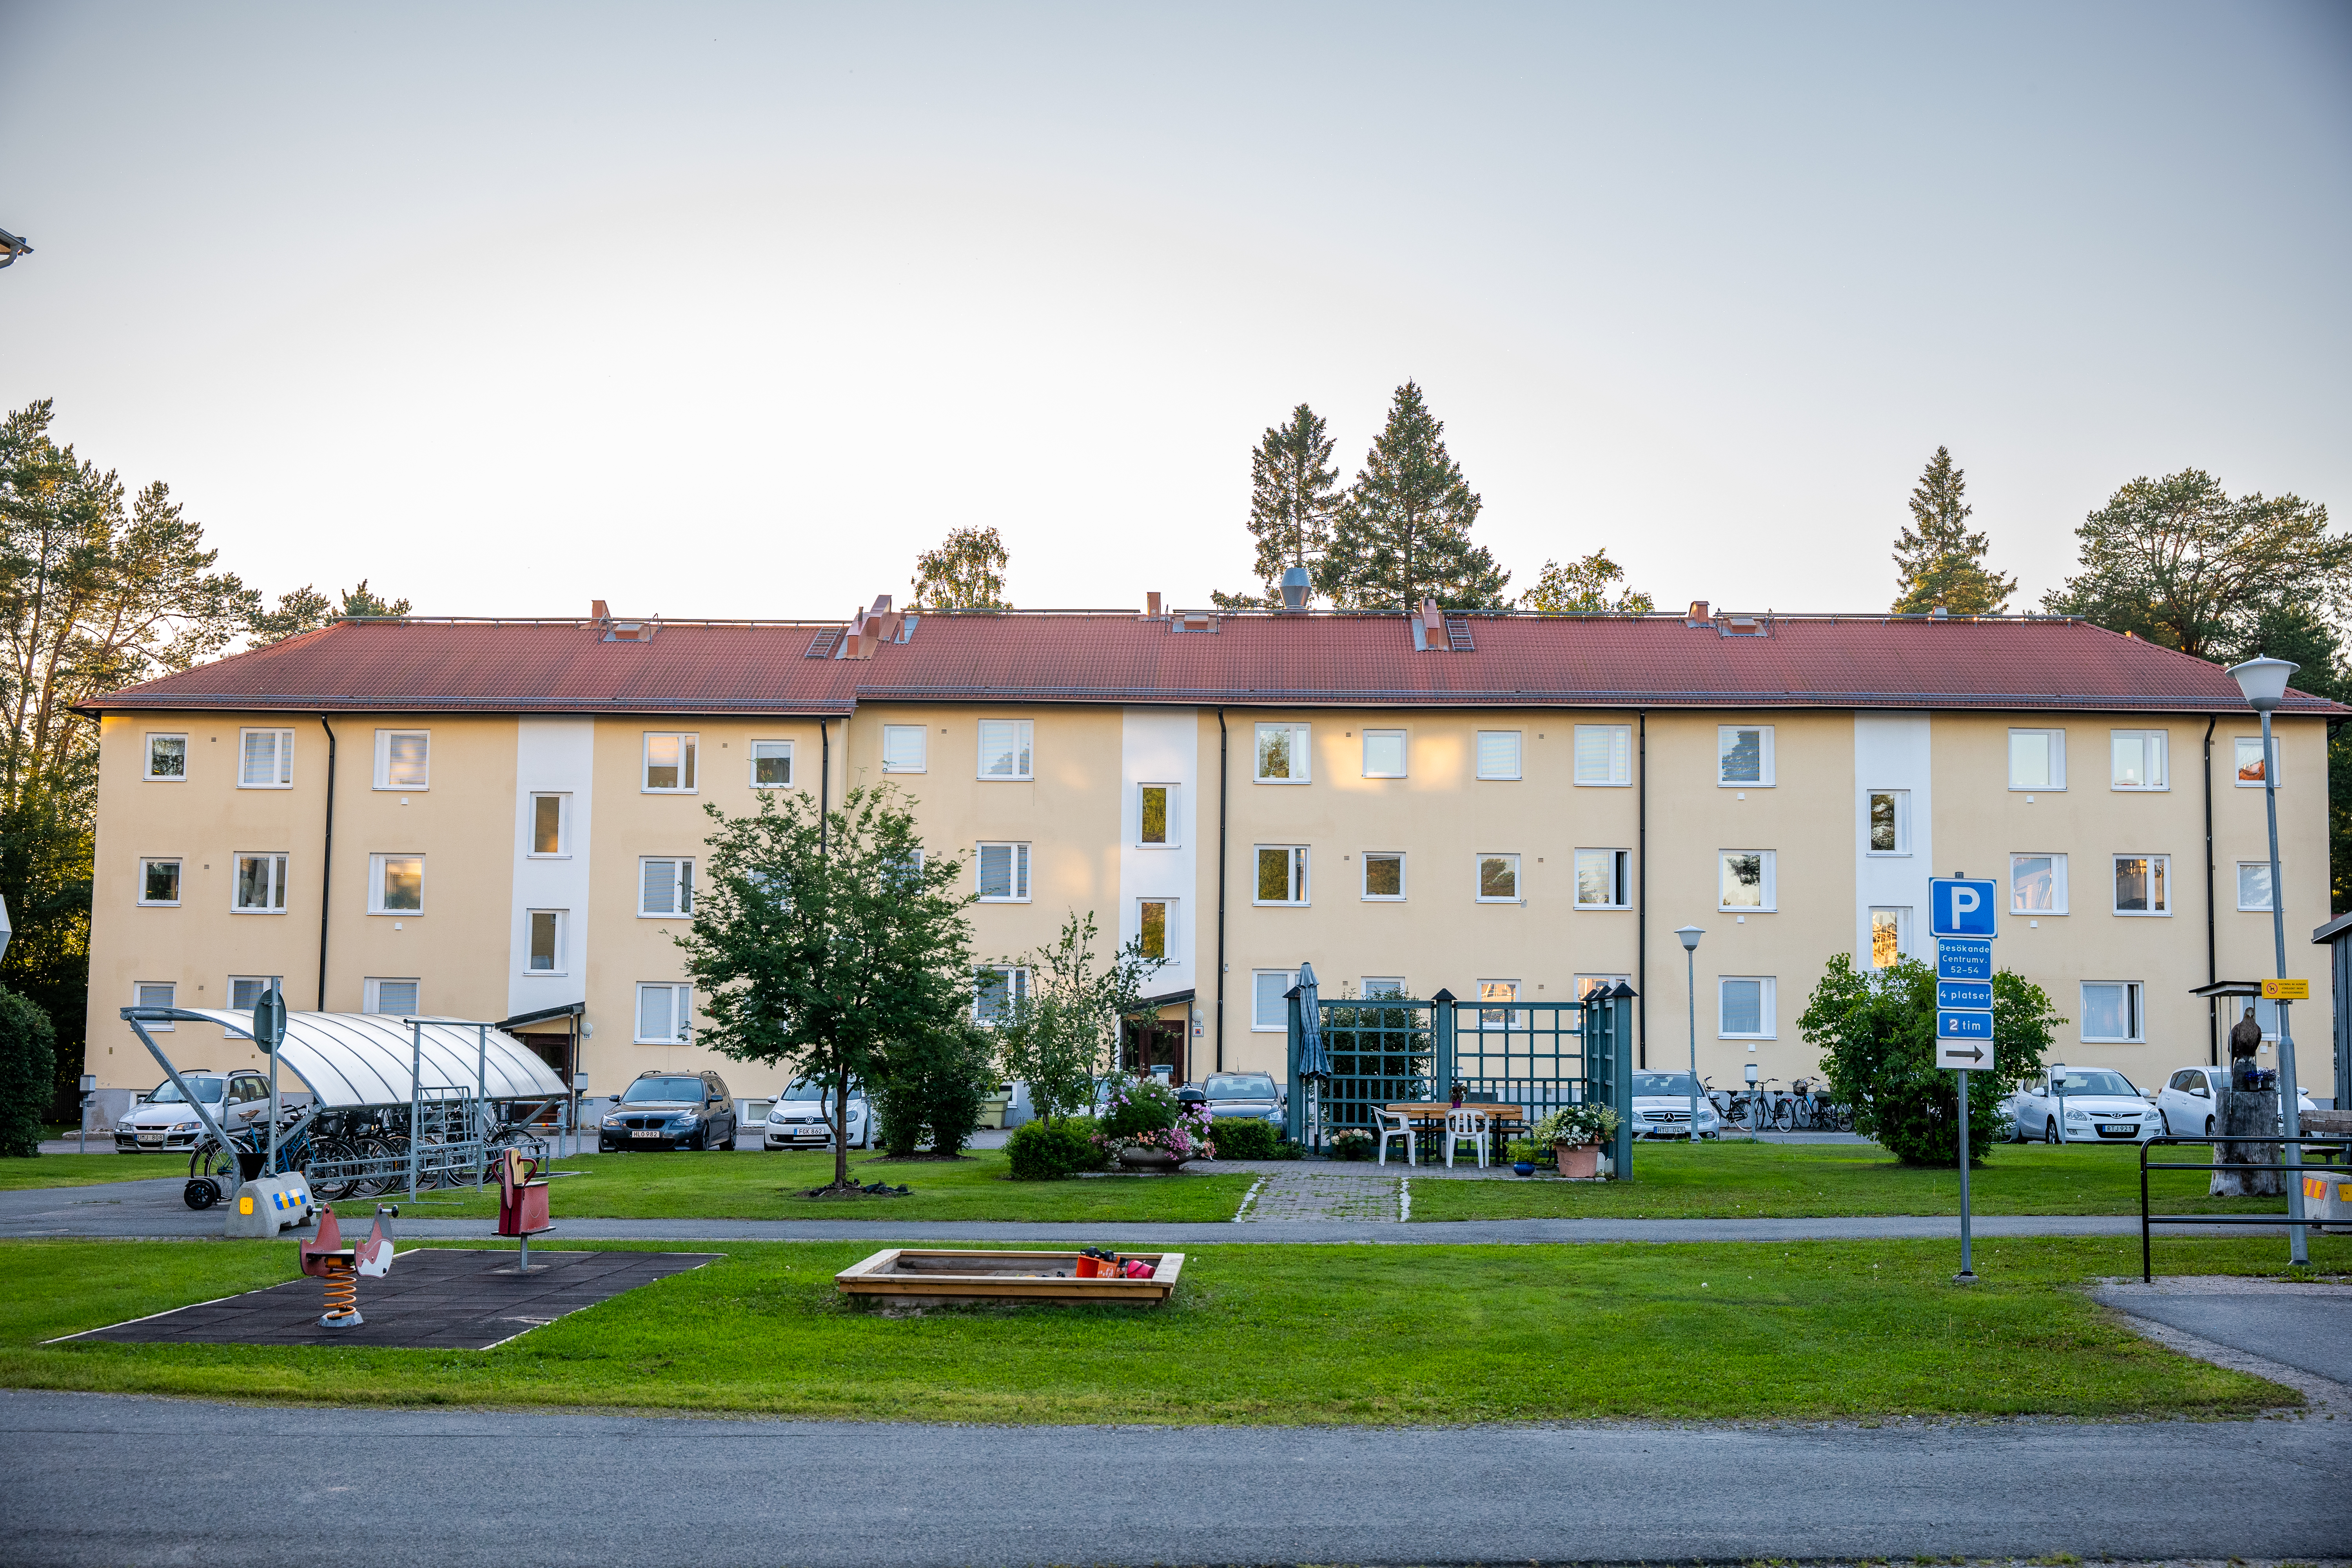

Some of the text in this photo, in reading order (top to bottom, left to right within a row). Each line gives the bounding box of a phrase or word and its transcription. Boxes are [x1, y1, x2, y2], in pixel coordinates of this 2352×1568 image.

[1951, 886, 1980, 929] P
[1940, 944, 1989, 953] Besökande
[1942, 955, 1987, 963] Centrumv.
[1951, 991, 1990, 1000] platser
[1949, 1019, 1980, 1030] 2 tim
